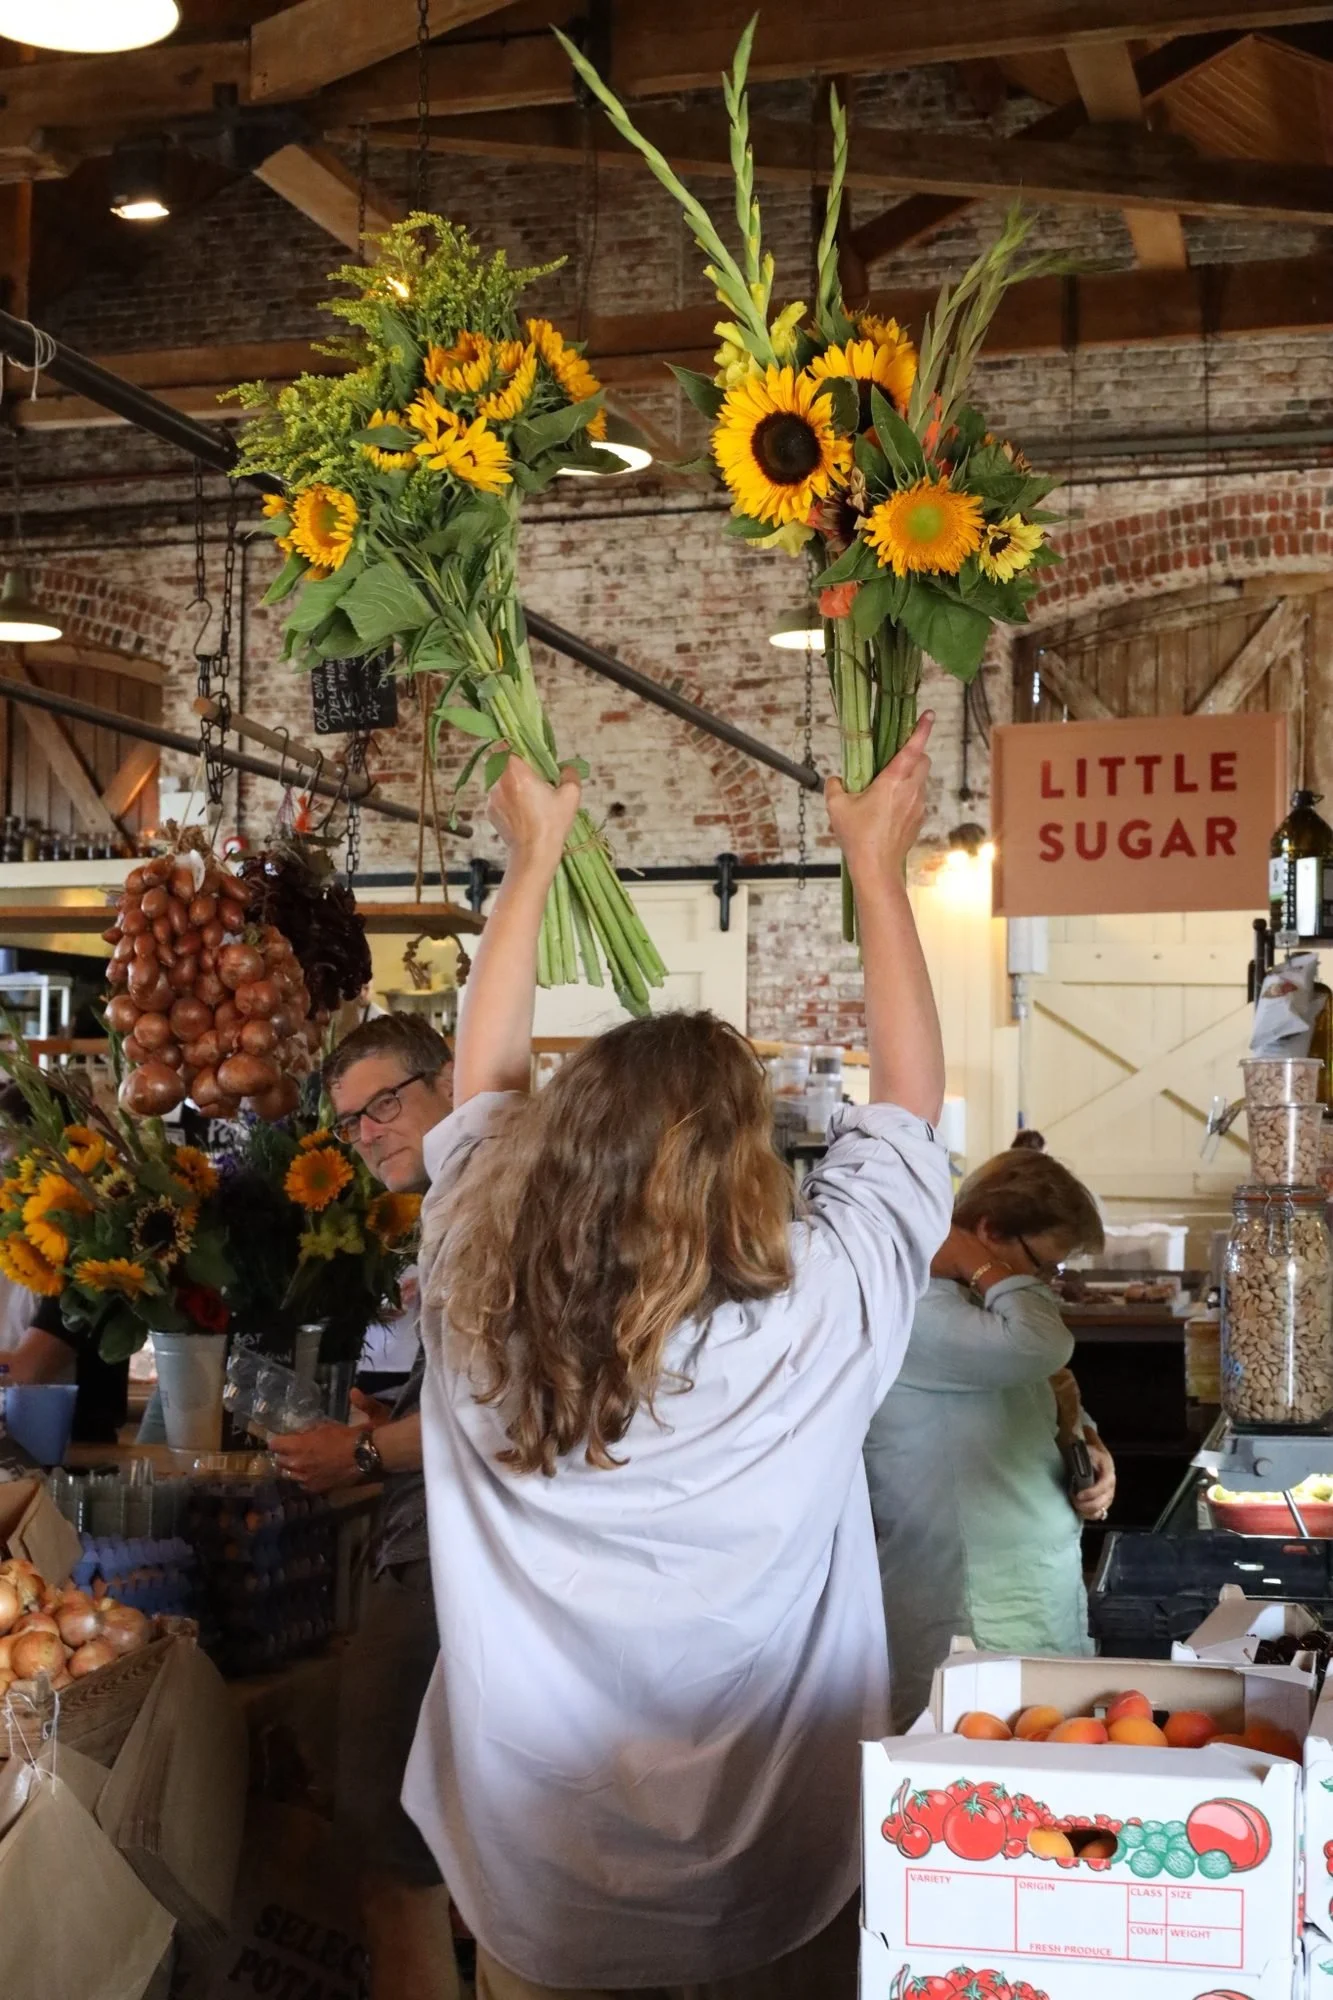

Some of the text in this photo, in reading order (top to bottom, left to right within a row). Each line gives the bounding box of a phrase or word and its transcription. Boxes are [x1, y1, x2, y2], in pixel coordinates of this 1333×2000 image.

[1040, 751, 1238, 799] LITTLE
[1038, 816, 1238, 863] SUGAR
[910, 1873, 951, 1884] VARIETY
[1019, 1881, 1056, 1892] ORIGIN
[1130, 1887, 1163, 1898] CLASS
[1170, 1890, 1193, 1900] SIZE
[1130, 1926, 1164, 1937] COUNT
[1170, 1928, 1211, 1940] WEIGHT
[253, 1903, 367, 1981] SELEC
[1029, 1943, 1113, 1957] FRESH PRODUCE
